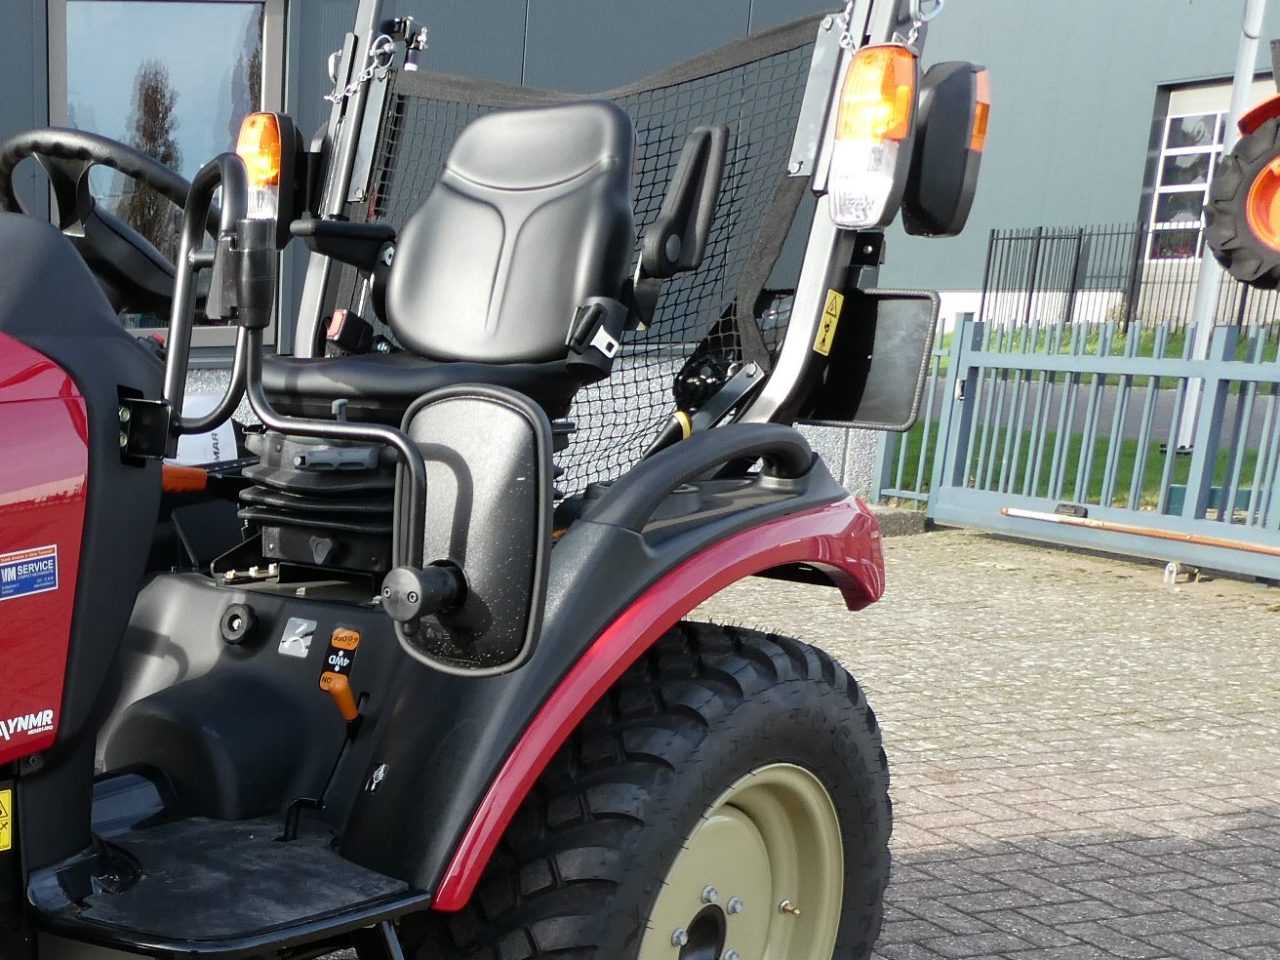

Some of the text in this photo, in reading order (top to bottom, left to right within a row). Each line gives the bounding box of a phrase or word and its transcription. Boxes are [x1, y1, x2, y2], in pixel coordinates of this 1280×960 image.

[0, 566, 17, 583] VM
[17, 559, 54, 576] SERVICE
[328, 654, 350, 667] 4WD
[6, 709, 54, 734] YNMR
[27, 725, 54, 735] NEDERLAND
